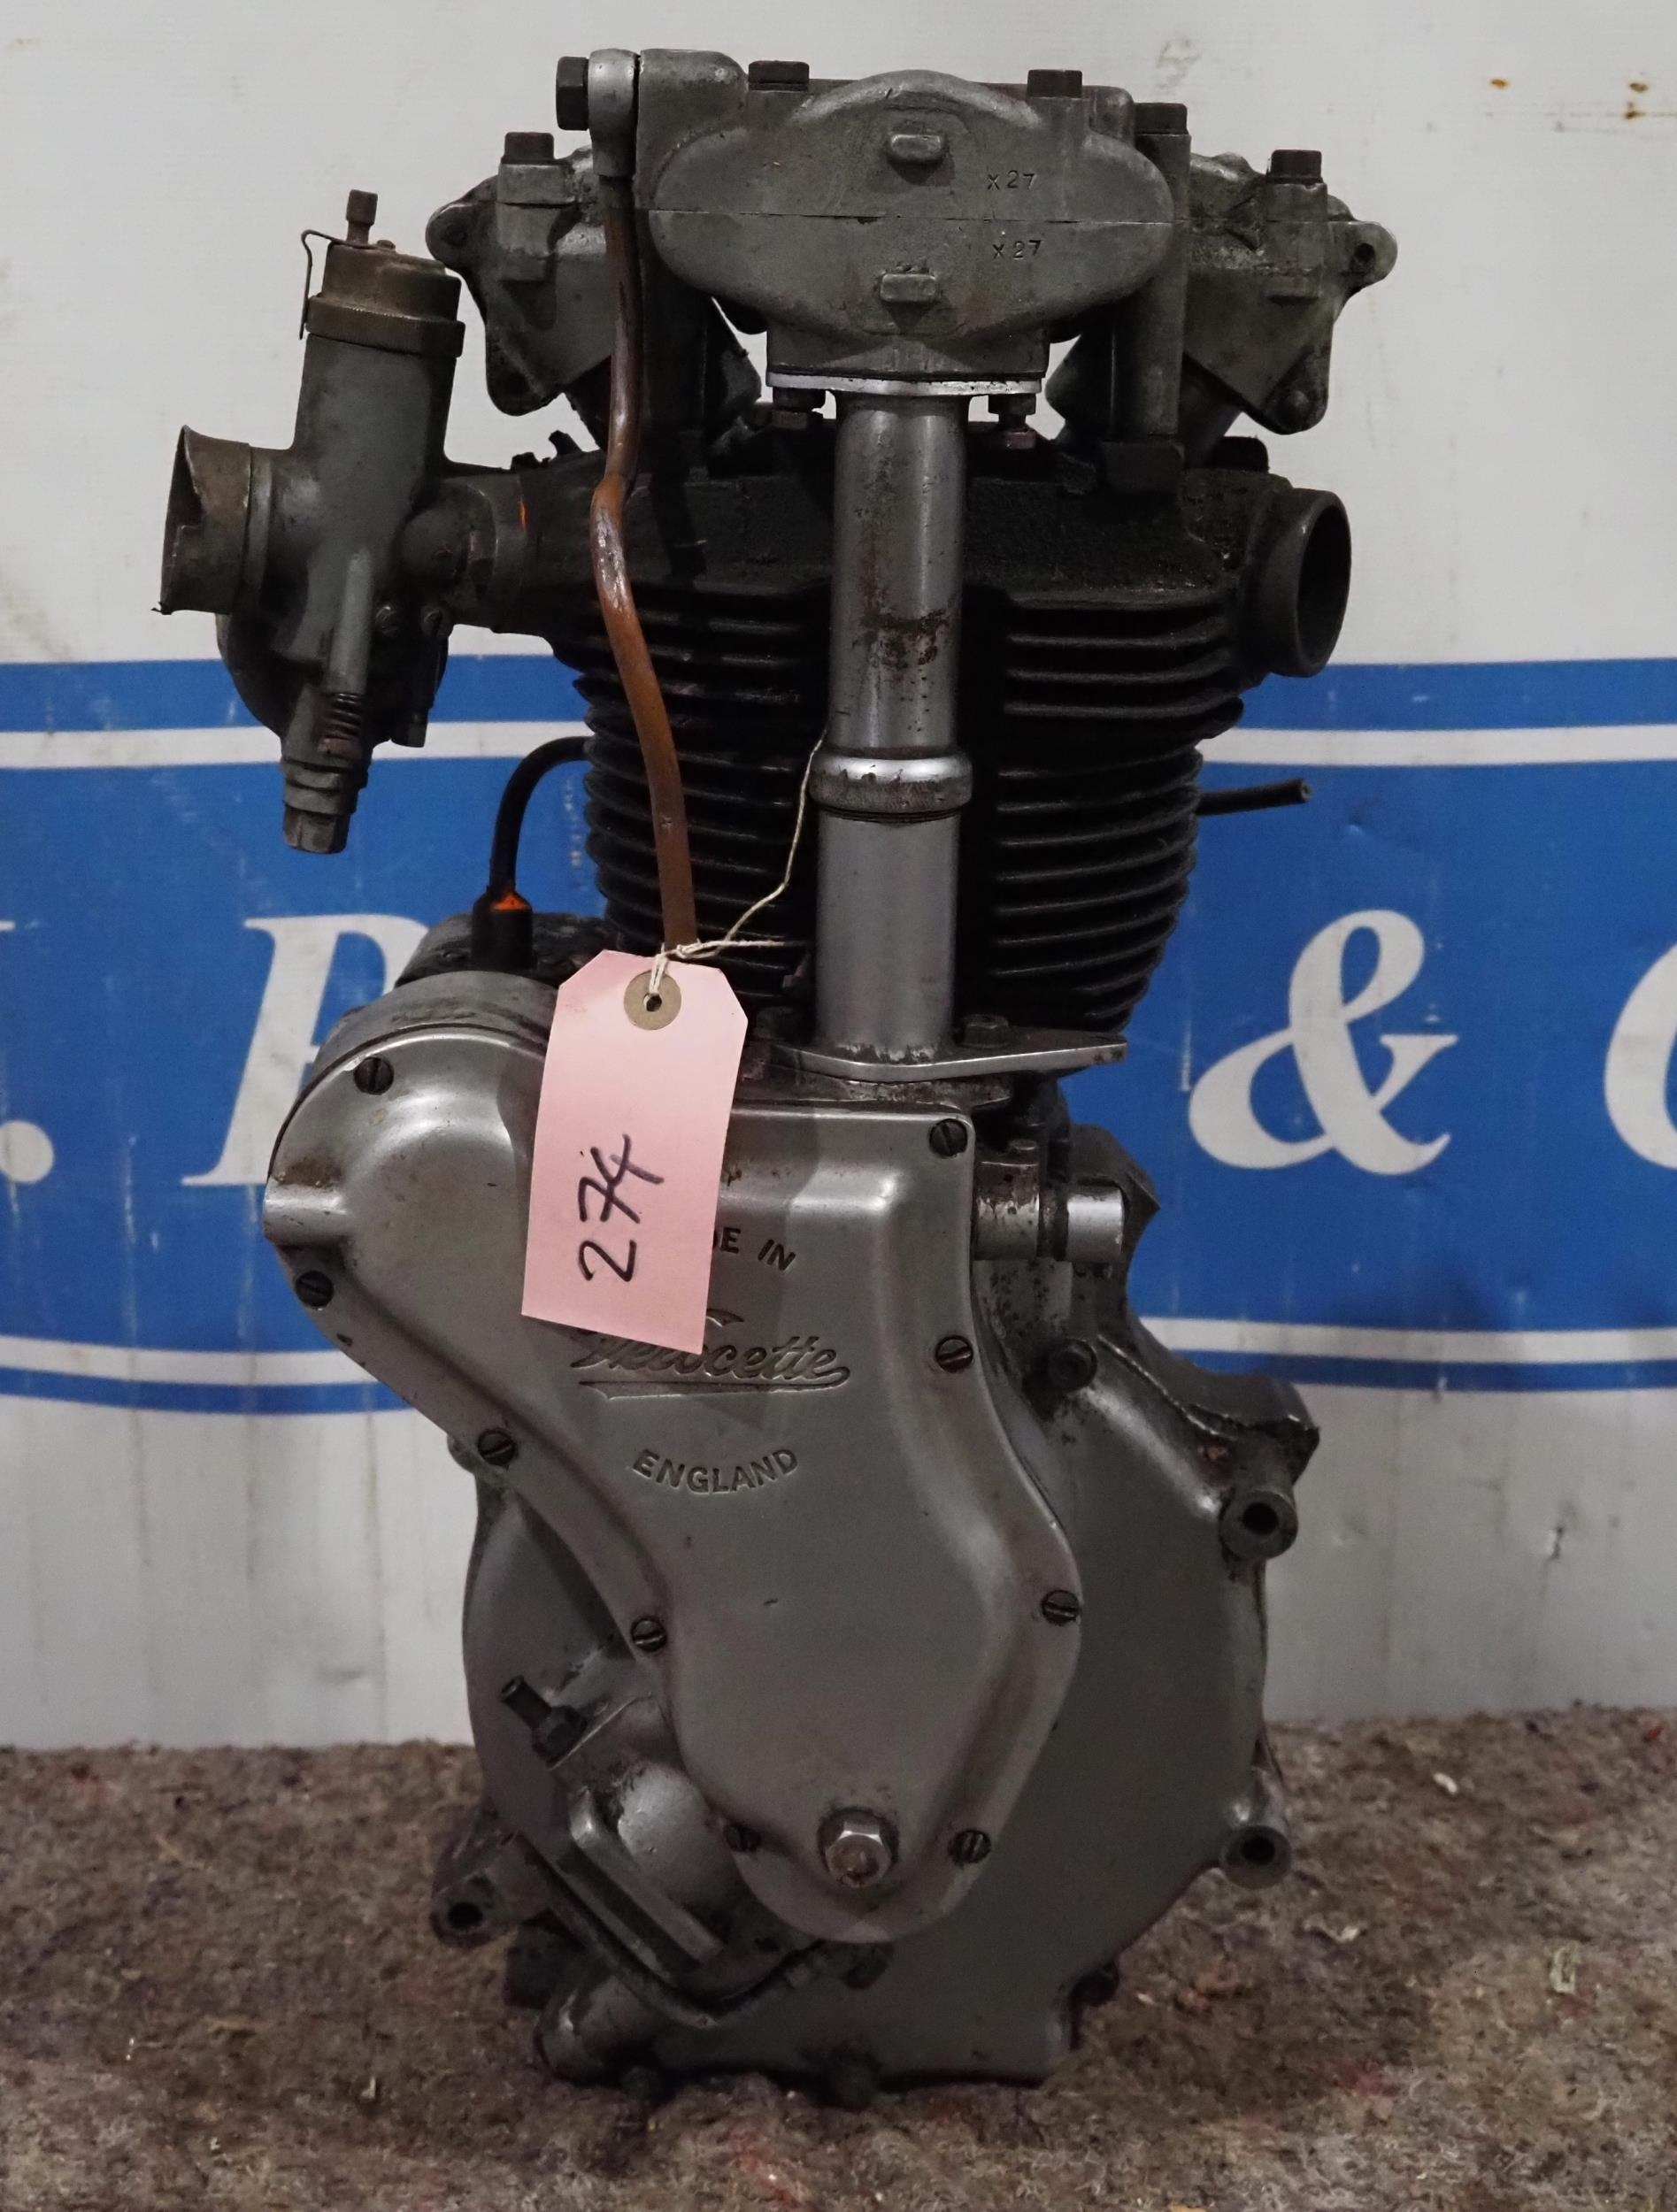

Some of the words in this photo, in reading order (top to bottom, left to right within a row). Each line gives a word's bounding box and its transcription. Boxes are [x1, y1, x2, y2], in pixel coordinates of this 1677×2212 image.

[1189, 909, 1458, 1175] &
[758, 1239, 796, 1271] IN
[631, 1448, 798, 1494] ENGLAND
